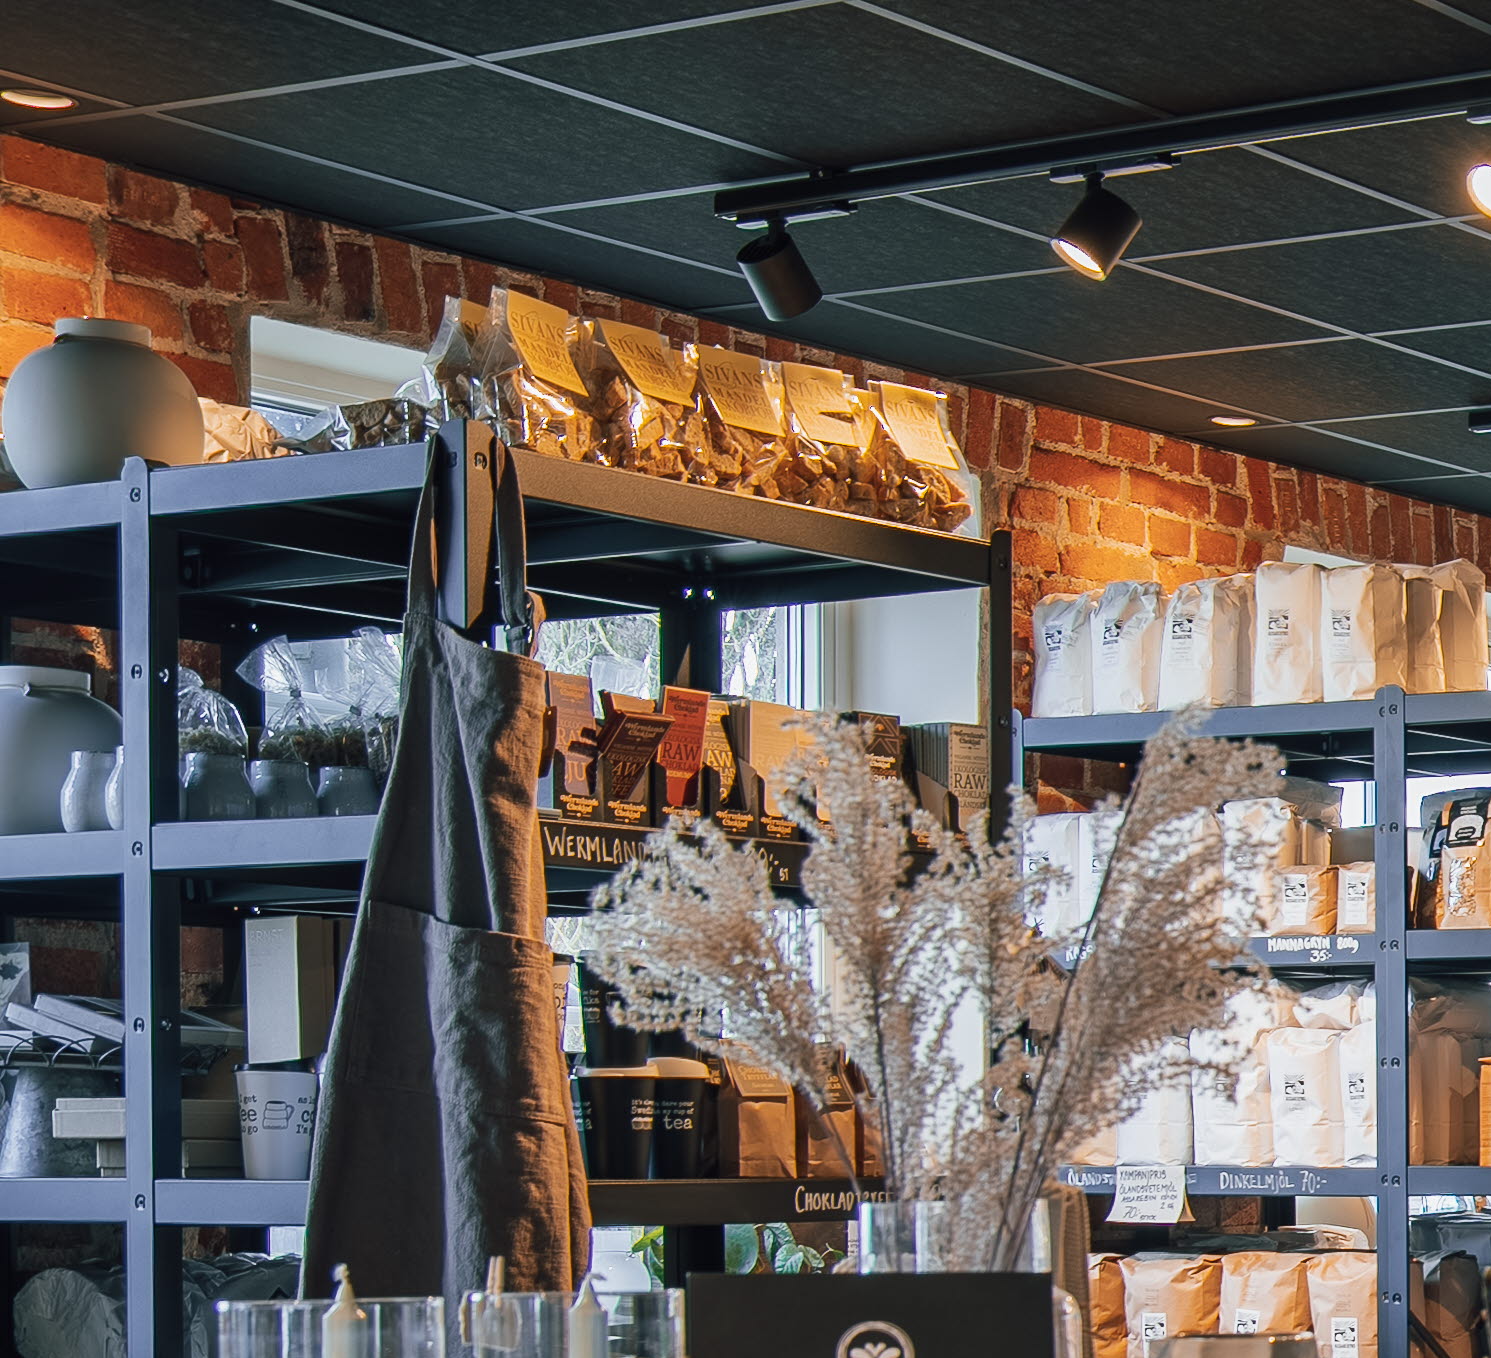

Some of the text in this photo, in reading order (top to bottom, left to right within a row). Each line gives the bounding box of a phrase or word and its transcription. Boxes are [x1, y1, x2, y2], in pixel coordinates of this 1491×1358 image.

[511, 312, 566, 344] SIVANS
[610, 335, 665, 363] SIVANS
[704, 364, 763, 388] SIVANS
[663, 742, 700, 762] RAW
[954, 773, 987, 790] RAW
[663, 1115, 694, 1130] tea
[1219, 1171, 1295, 1194] DINKELMJÖL
